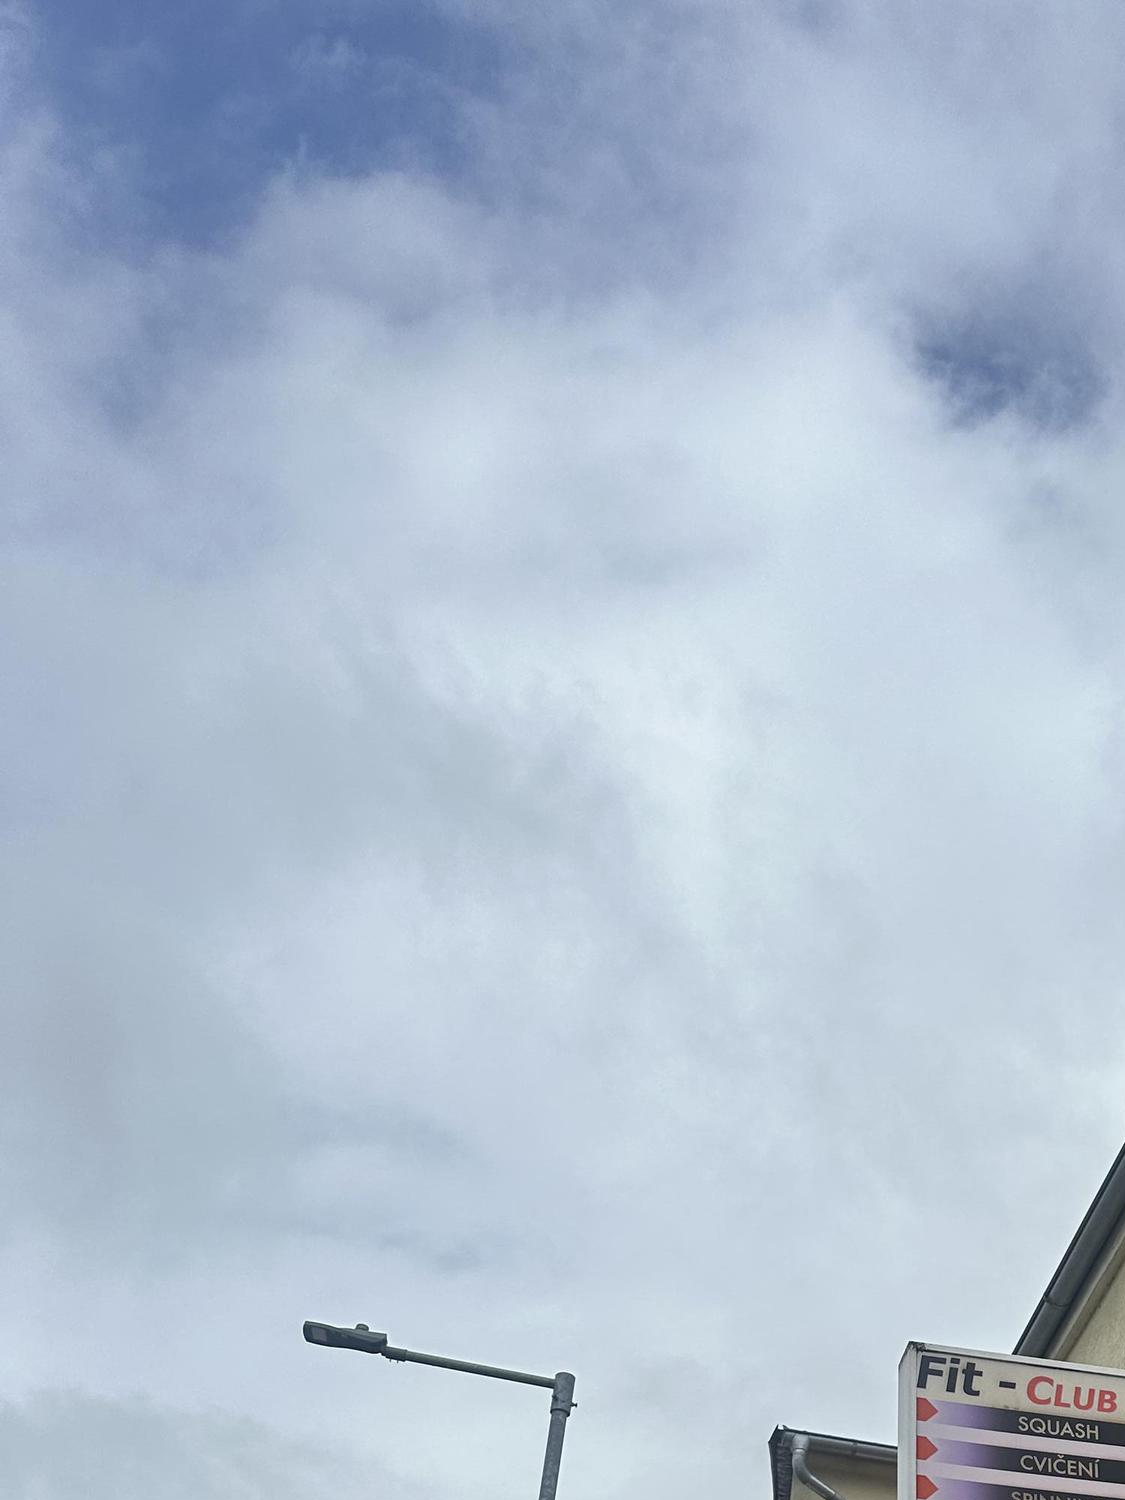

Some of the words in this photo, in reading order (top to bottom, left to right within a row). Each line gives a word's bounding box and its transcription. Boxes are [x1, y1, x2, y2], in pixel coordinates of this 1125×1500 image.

[916, 1355, 983, 1396] Fit
[1026, 1376, 1118, 1413] CLUB
[1018, 1416, 1100, 1441] SQUASH
[1019, 1453, 1100, 1478] CVIČENÍ
